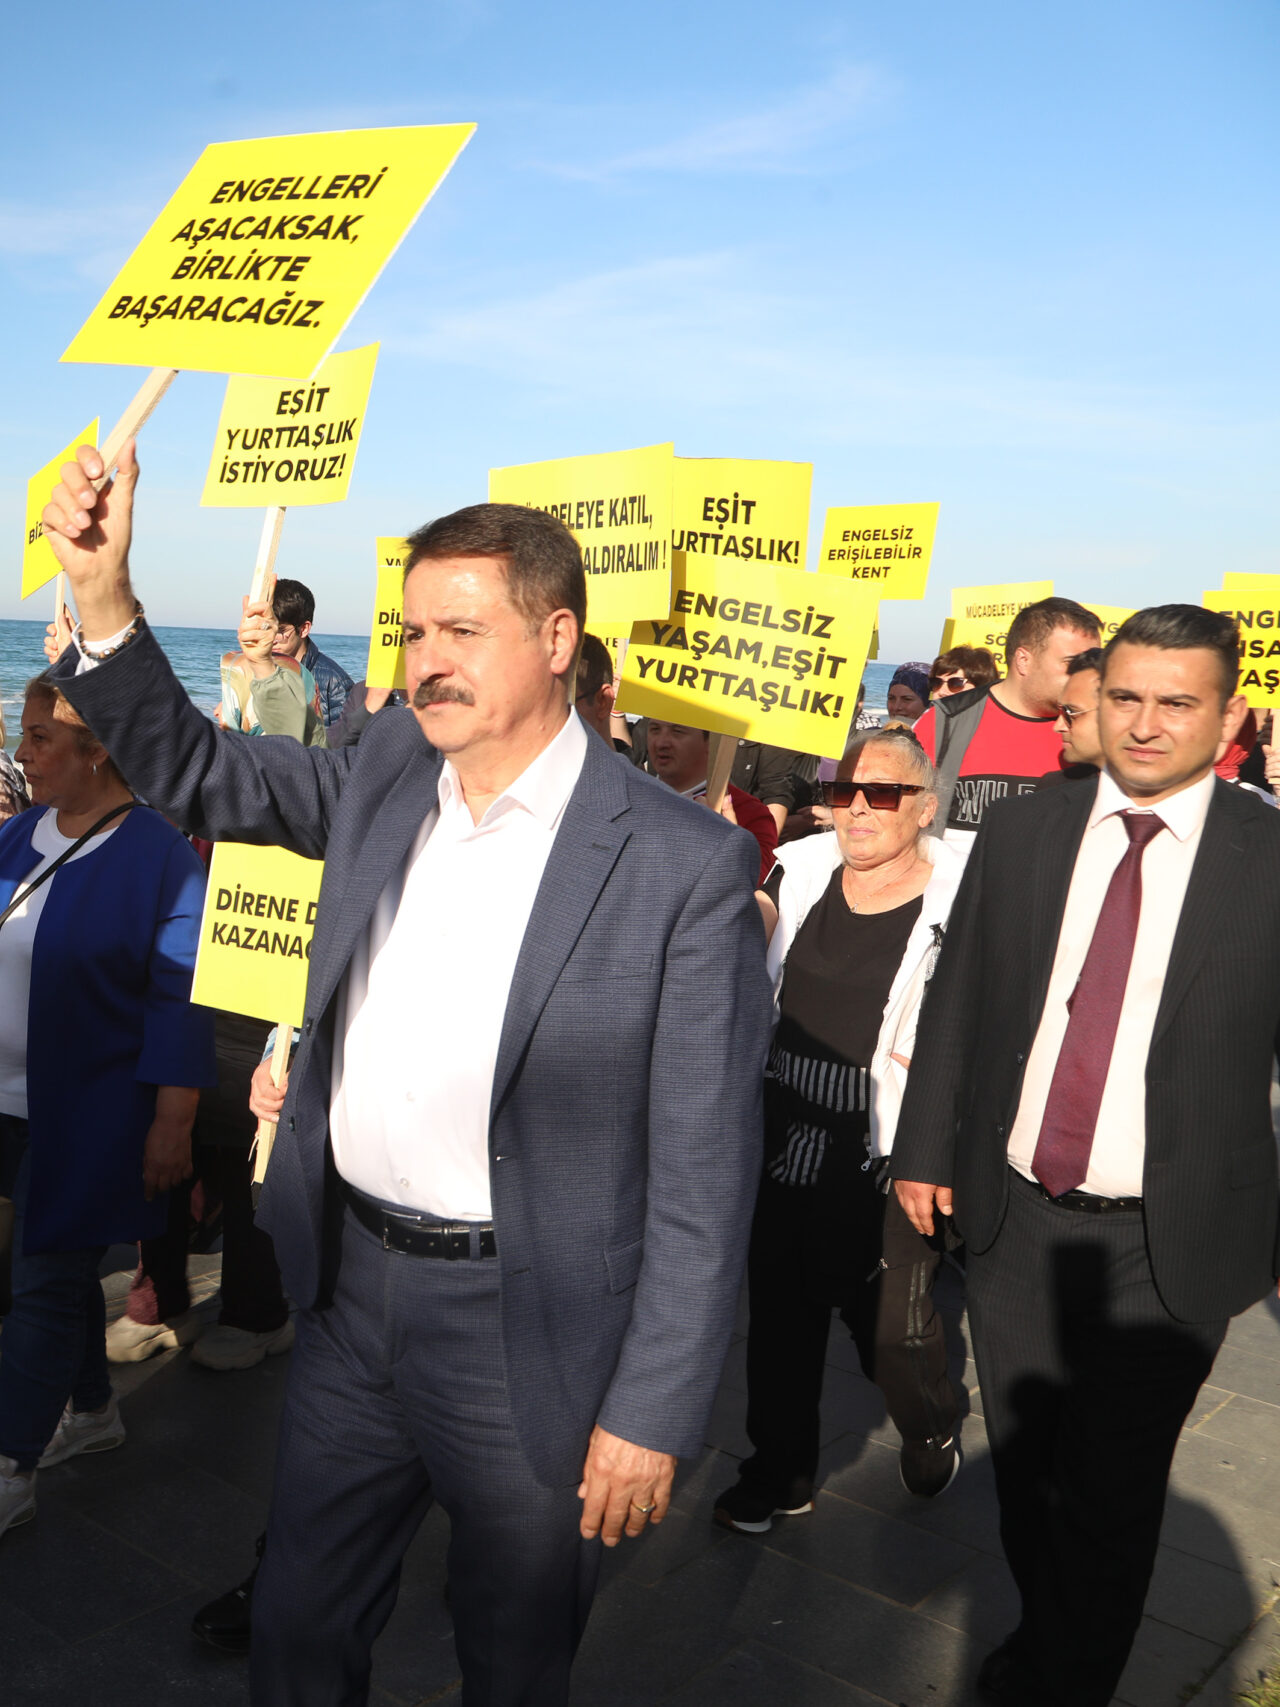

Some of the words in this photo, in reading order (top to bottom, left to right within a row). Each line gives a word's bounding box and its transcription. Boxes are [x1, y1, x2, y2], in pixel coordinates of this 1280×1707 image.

[209, 166, 389, 204] ENGELLERİ
[170, 214, 365, 249] AŞACAKSAK,
[170, 248, 312, 282] BİRLİKTE
[108, 290, 325, 328] BAŞARACAĞIZ.
[276, 383, 330, 418] EŞİT
[226, 418, 357, 451] YURTTAŞLIK
[219, 453, 346, 484] İSTİYORUZ!
[609, 494, 653, 530] KATIL,
[702, 491, 756, 530] EŞİT
[671, 529, 800, 564] URTTAŞLIK!
[842, 525, 914, 541] ENGELSİZ
[584, 540, 659, 575] ALDIRALIM
[828, 543, 922, 564] ERİŞİLEBİLİR
[851, 566, 891, 579] KENT
[674, 589, 835, 639] ENGELSİZ
[635, 655, 844, 718] YURTTAŞLIK!
[216, 883, 300, 923] DİRENE
